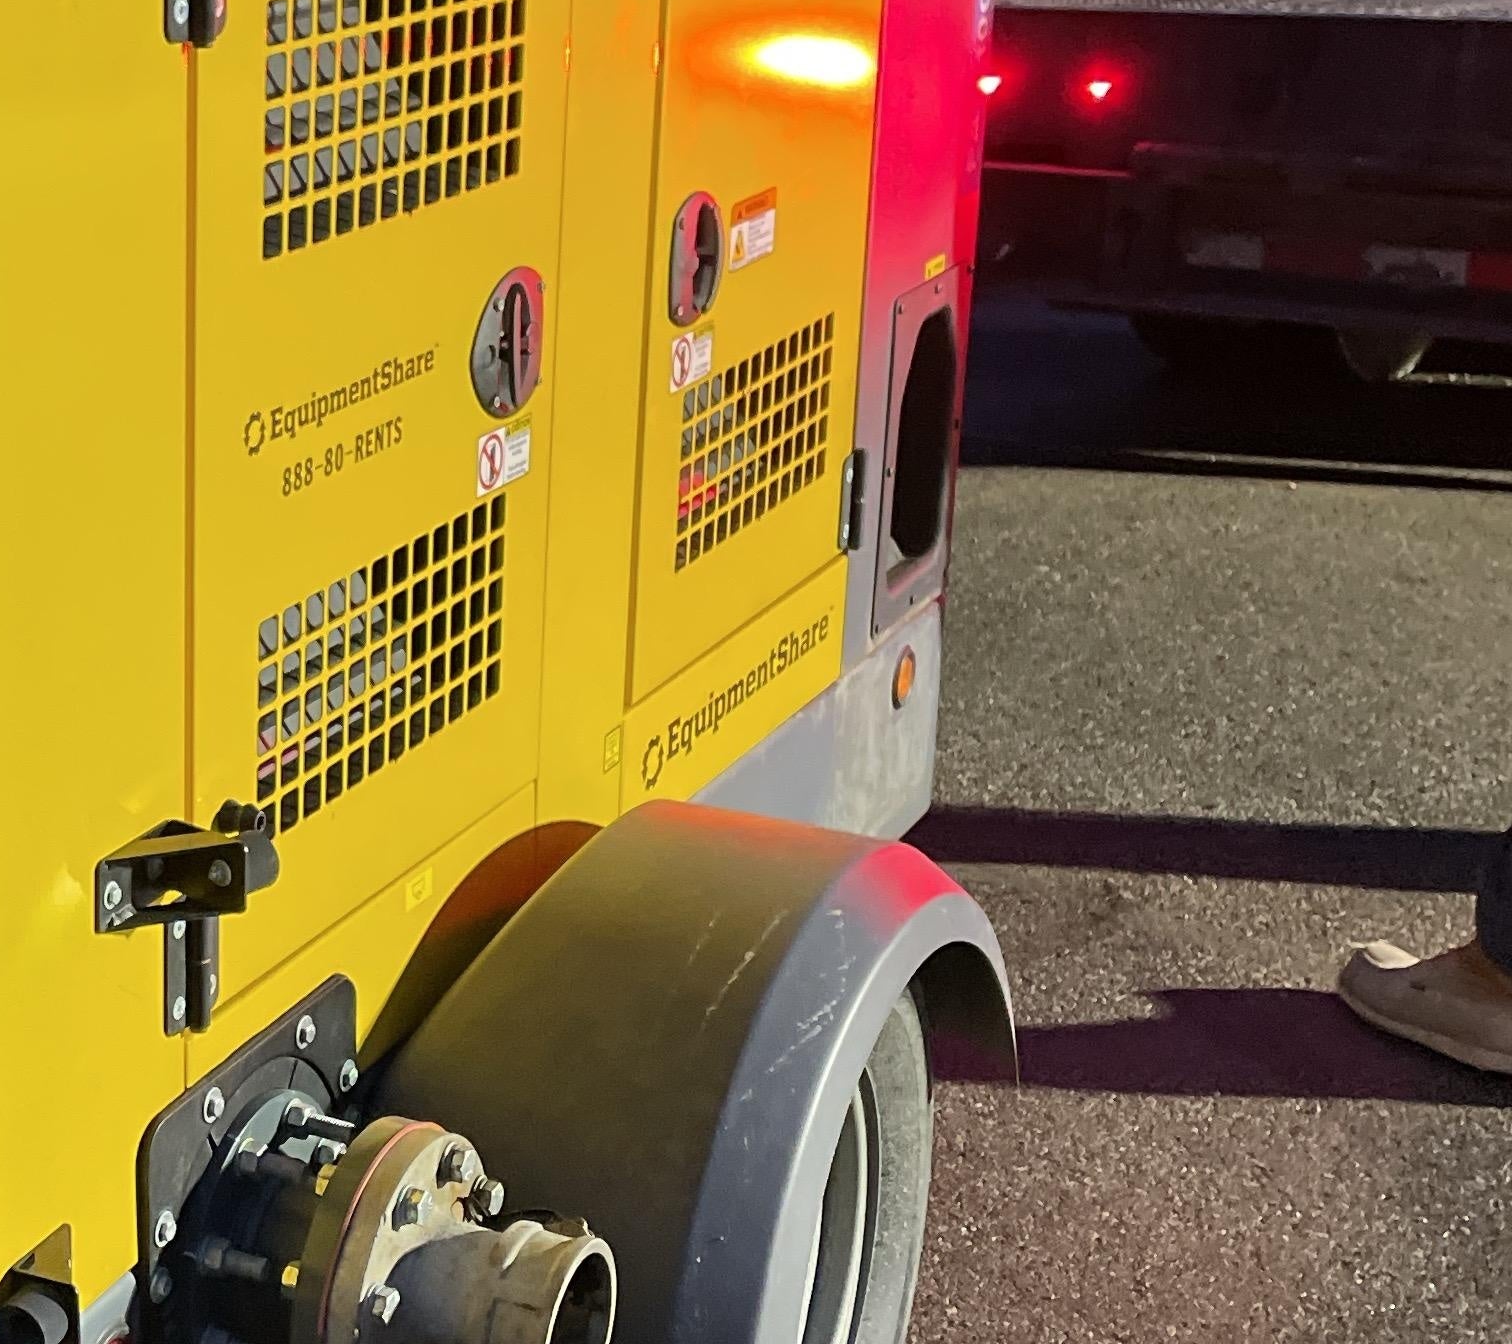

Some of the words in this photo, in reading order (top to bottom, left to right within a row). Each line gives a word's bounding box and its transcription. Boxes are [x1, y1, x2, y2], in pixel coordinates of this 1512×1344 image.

[269, 348, 435, 442] EquipmentShare
[282, 415, 403, 497] 888-80-RENTS
[666, 613, 830, 761] EquipmentShare
